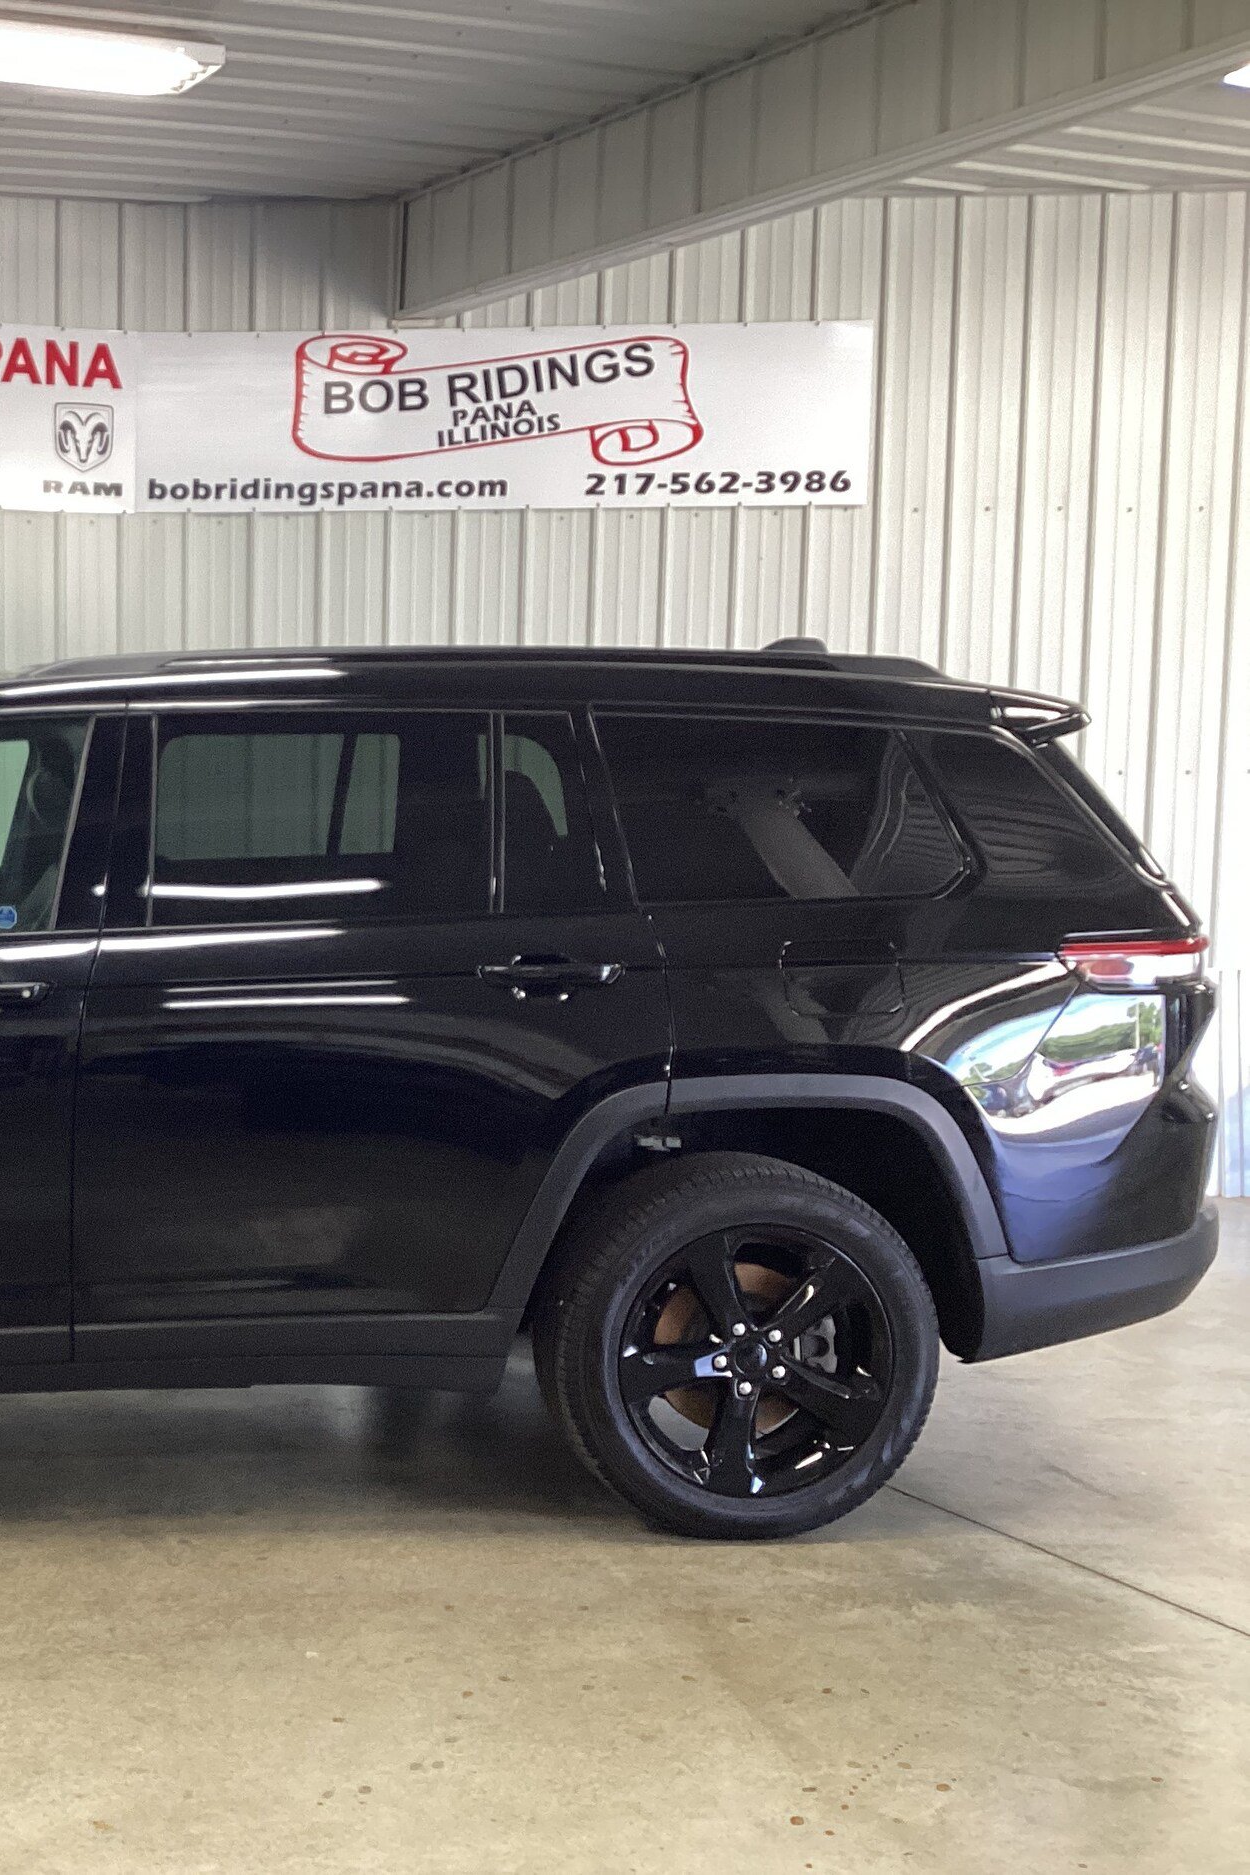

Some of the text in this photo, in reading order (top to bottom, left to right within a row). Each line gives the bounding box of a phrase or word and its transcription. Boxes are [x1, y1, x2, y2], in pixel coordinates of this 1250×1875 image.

[323, 342, 656, 415] BOB RIDINGS
[452, 399, 538, 427] PANA
[437, 413, 561, 447] ILLINOIS
[42, 479, 123, 497] RAM
[148, 478, 509, 506] bobridingspana.com
[584, 470, 852, 496] 217-562-3986
